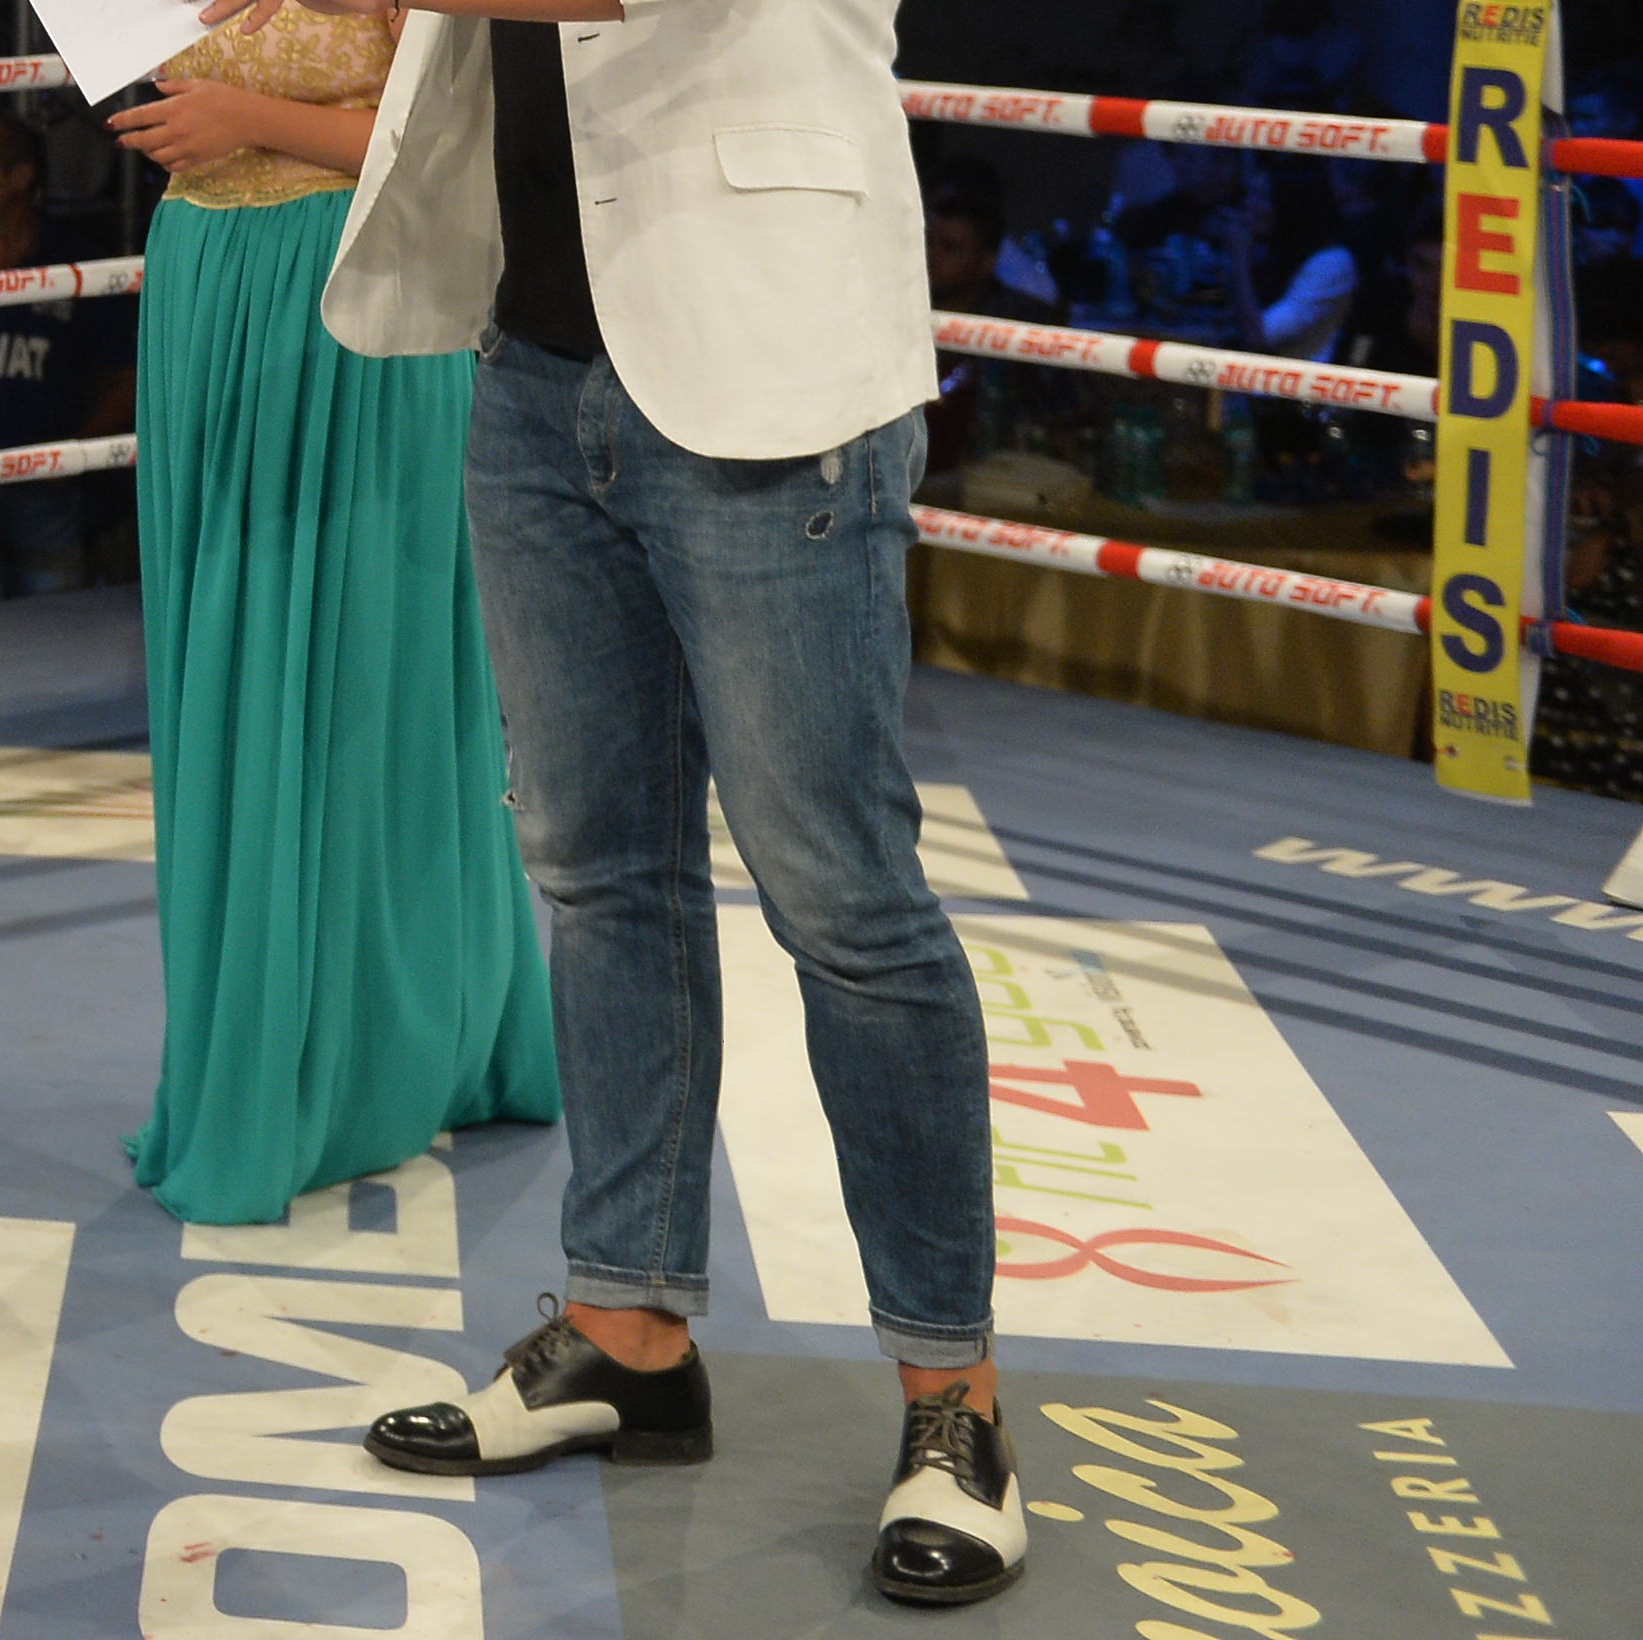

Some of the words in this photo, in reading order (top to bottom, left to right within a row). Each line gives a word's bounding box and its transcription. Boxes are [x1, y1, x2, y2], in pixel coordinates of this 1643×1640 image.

[1465, 2, 1545, 30] REDIS
[981, 94, 1064, 123] SOFT
[1204, 116, 1292, 147] AUTO
[1298, 121, 1391, 151] SOFT
[935, 319, 1012, 352] AUTO
[1014, 328, 1104, 362] SOFT
[1217, 362, 1304, 396] AUTO
[1311, 376, 1401, 406] SOFT
[1439, 66, 1529, 673] REDIS
[1, 448, 64, 478] SOFT
[987, 522, 1076, 555] SOFT
[1196, 562, 1285, 597] AUTO
[1291, 577, 1387, 612] SOFT
[1439, 689, 1517, 721] REDIS
[1357, 1415, 1554, 1640] ZZERIA
